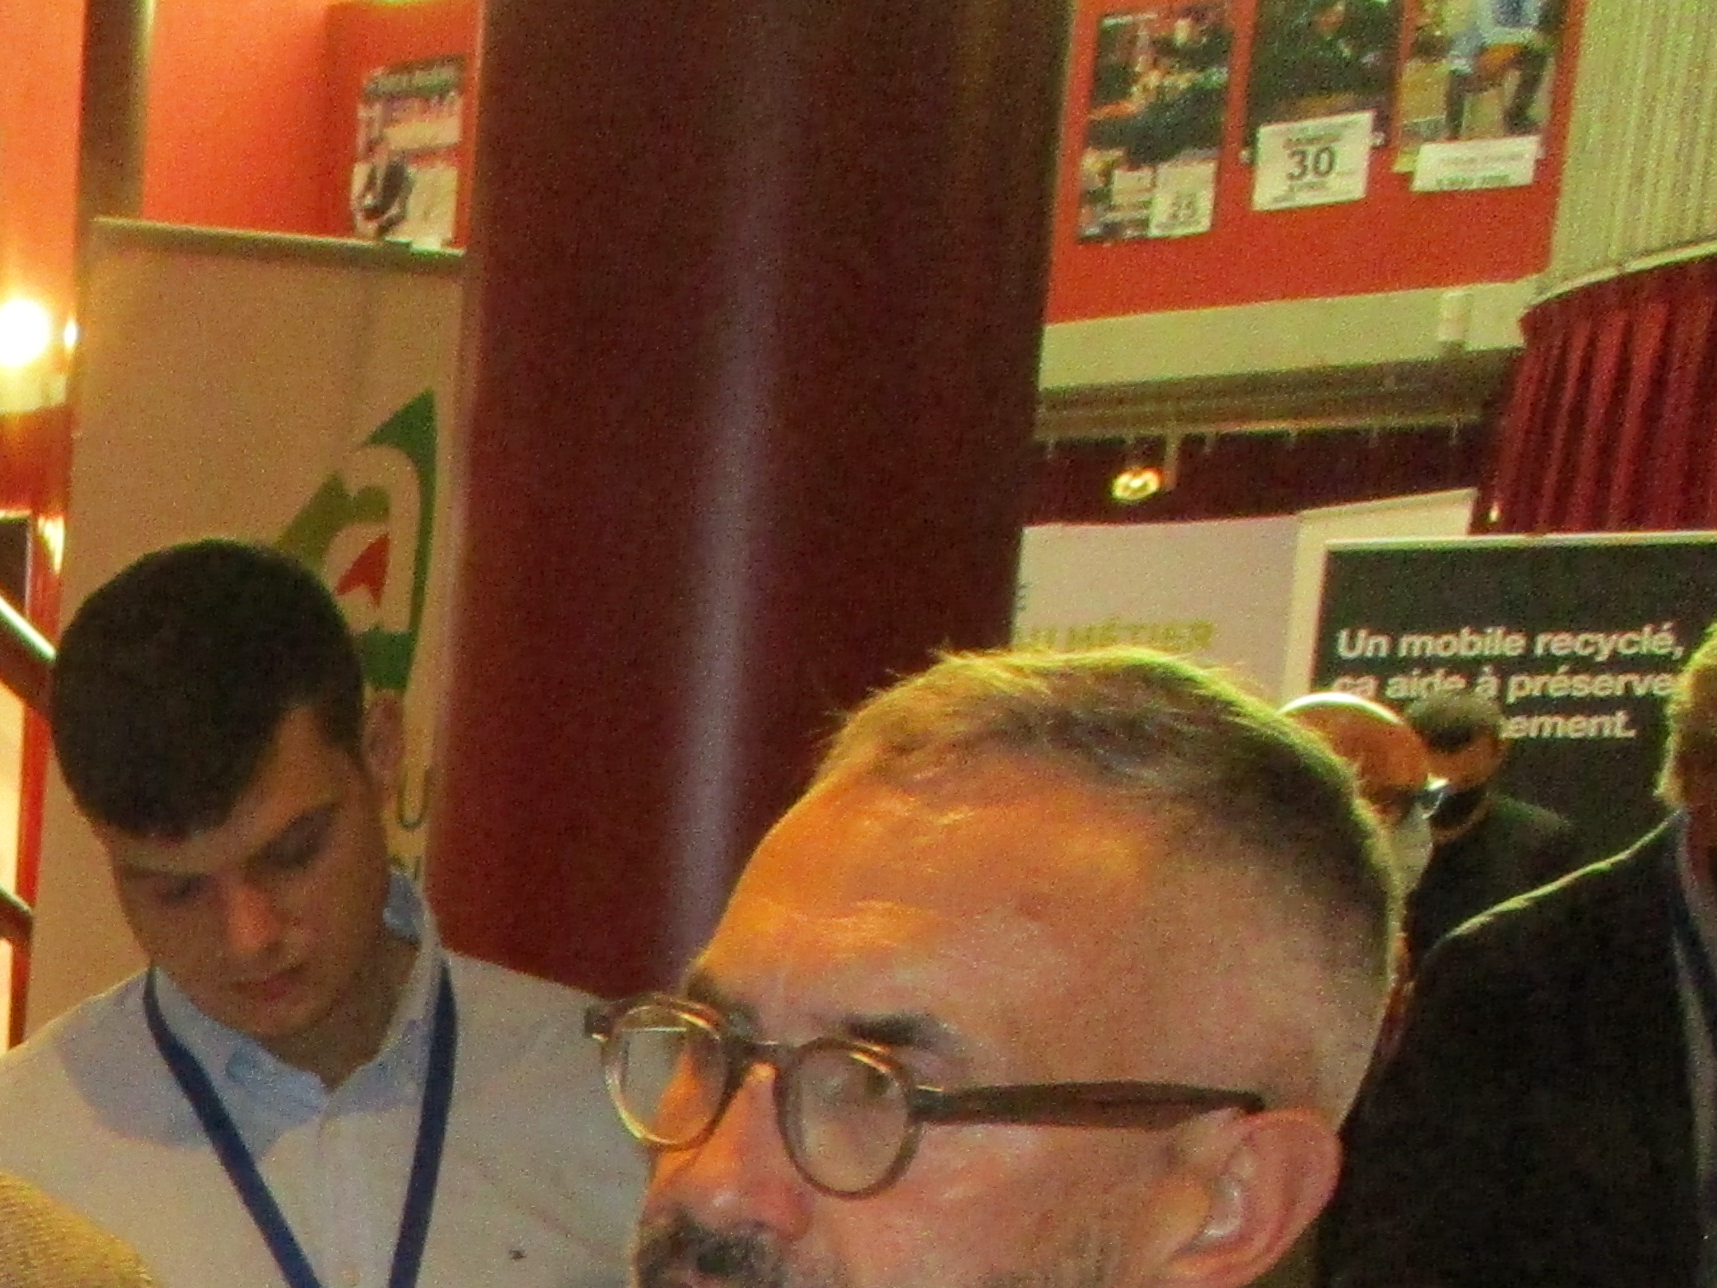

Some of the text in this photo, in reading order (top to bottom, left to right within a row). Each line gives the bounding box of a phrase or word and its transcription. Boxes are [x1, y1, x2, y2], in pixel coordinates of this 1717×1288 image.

[1287, 144, 1337, 181] 30
[1337, 621, 1684, 662] Un mobile recyclé,
